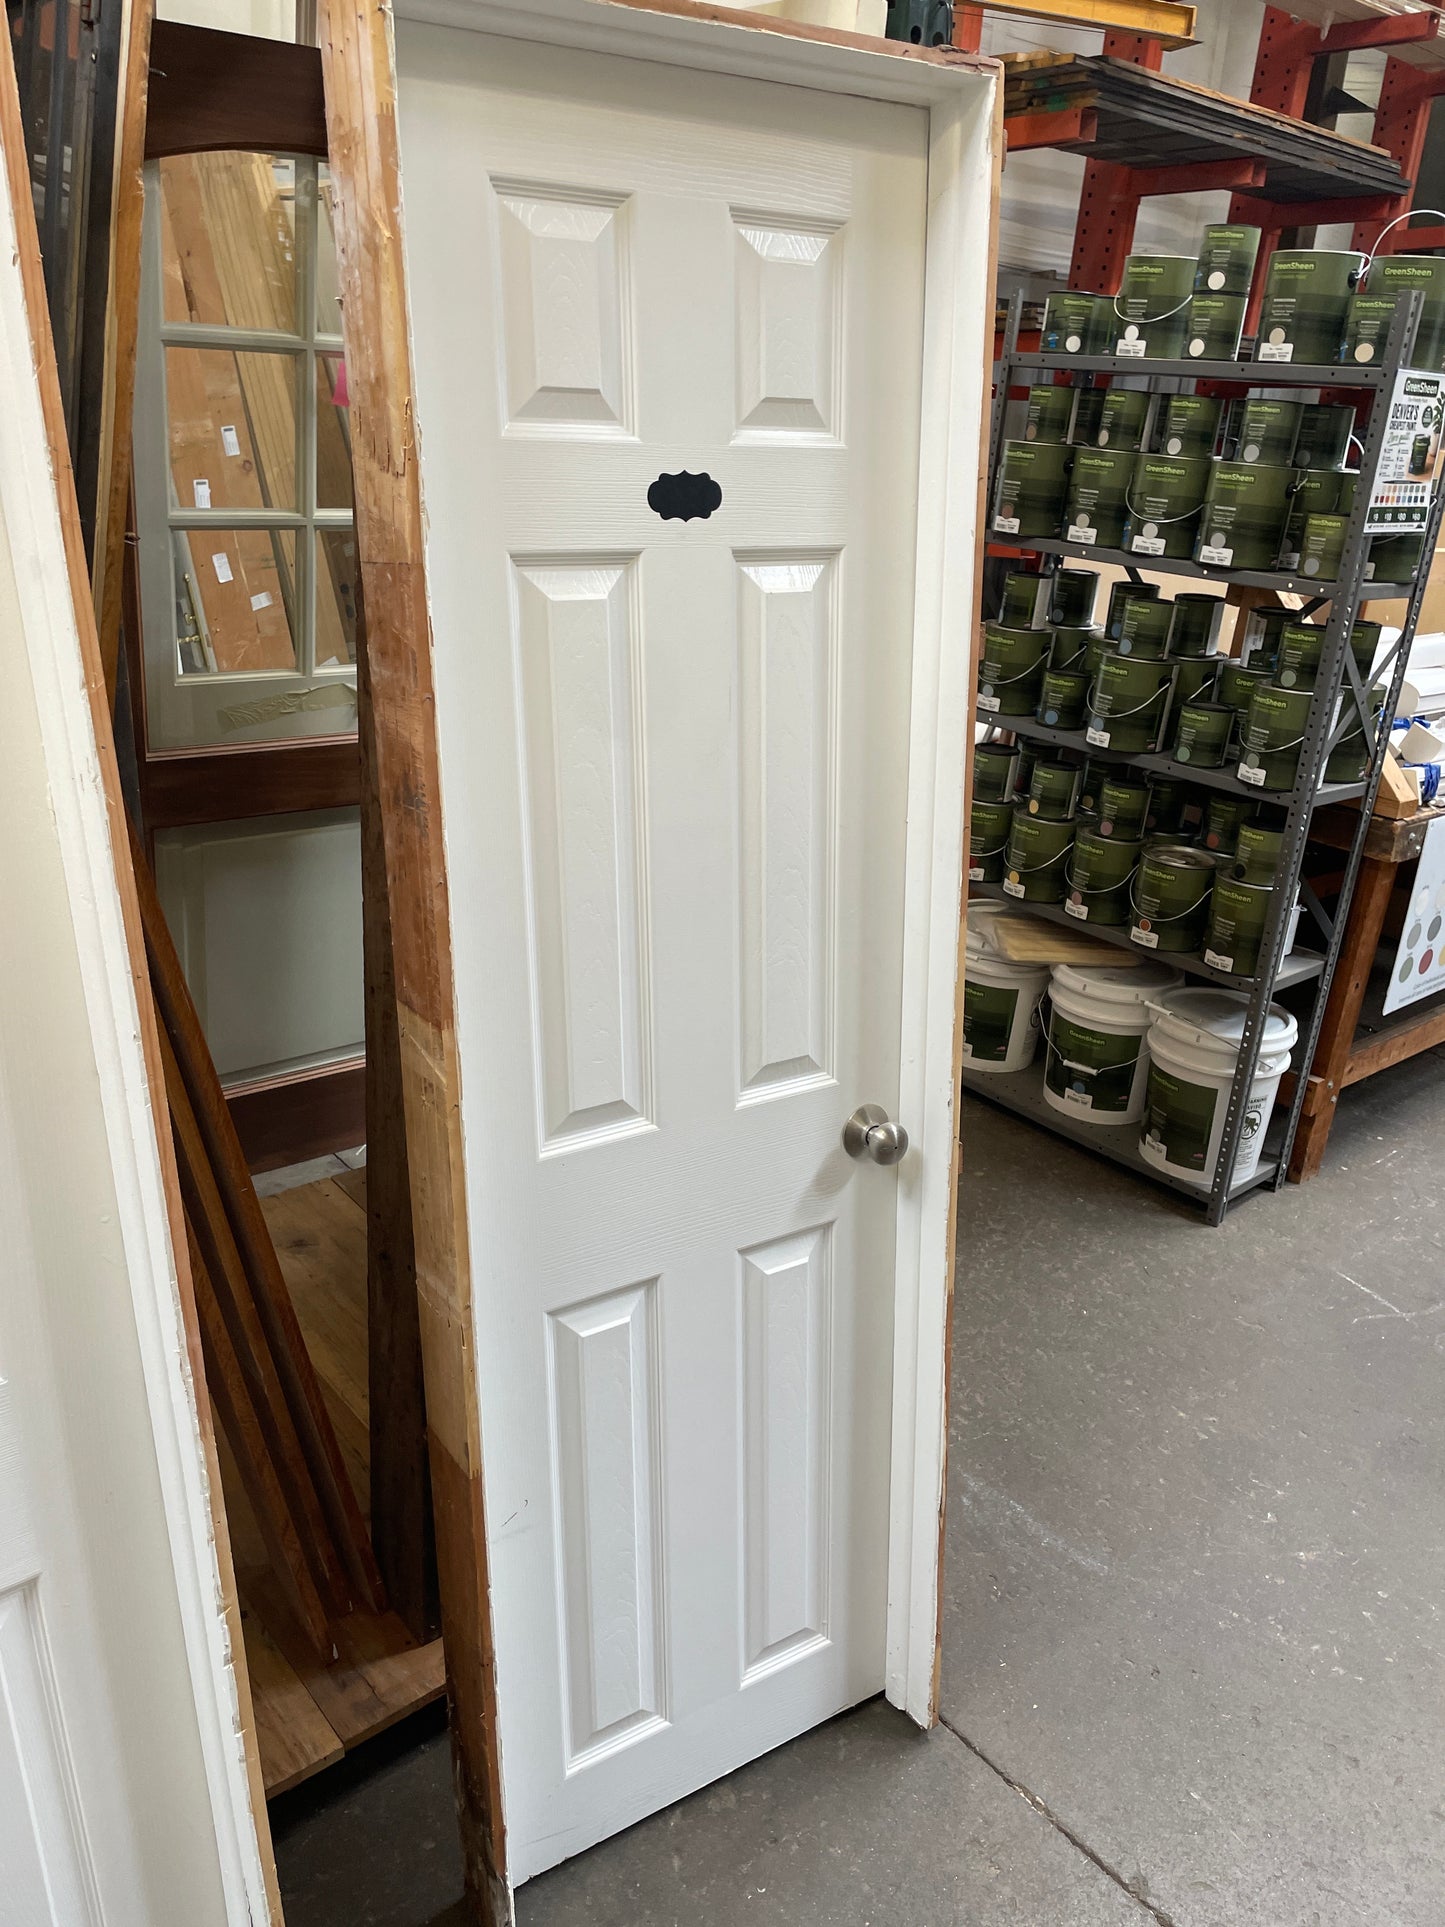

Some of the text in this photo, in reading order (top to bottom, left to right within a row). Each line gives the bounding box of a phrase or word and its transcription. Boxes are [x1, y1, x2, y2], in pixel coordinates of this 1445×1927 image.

[1274, 262, 1315, 271] GreenSheen
[1384, 267, 1432, 277] GreenSheen
[1355, 301, 1396, 309] GreenSheen
[1405, 380, 1437, 394] GreenSheen
[1391, 403, 1420, 420] DENVER'S
[1079, 457, 1114, 467] GreenSheen
[1145, 464, 1186, 476] GreenSheen
[1215, 471, 1255, 483] GreenSheen
[1069, 1029, 1106, 1046] GreenSheen
